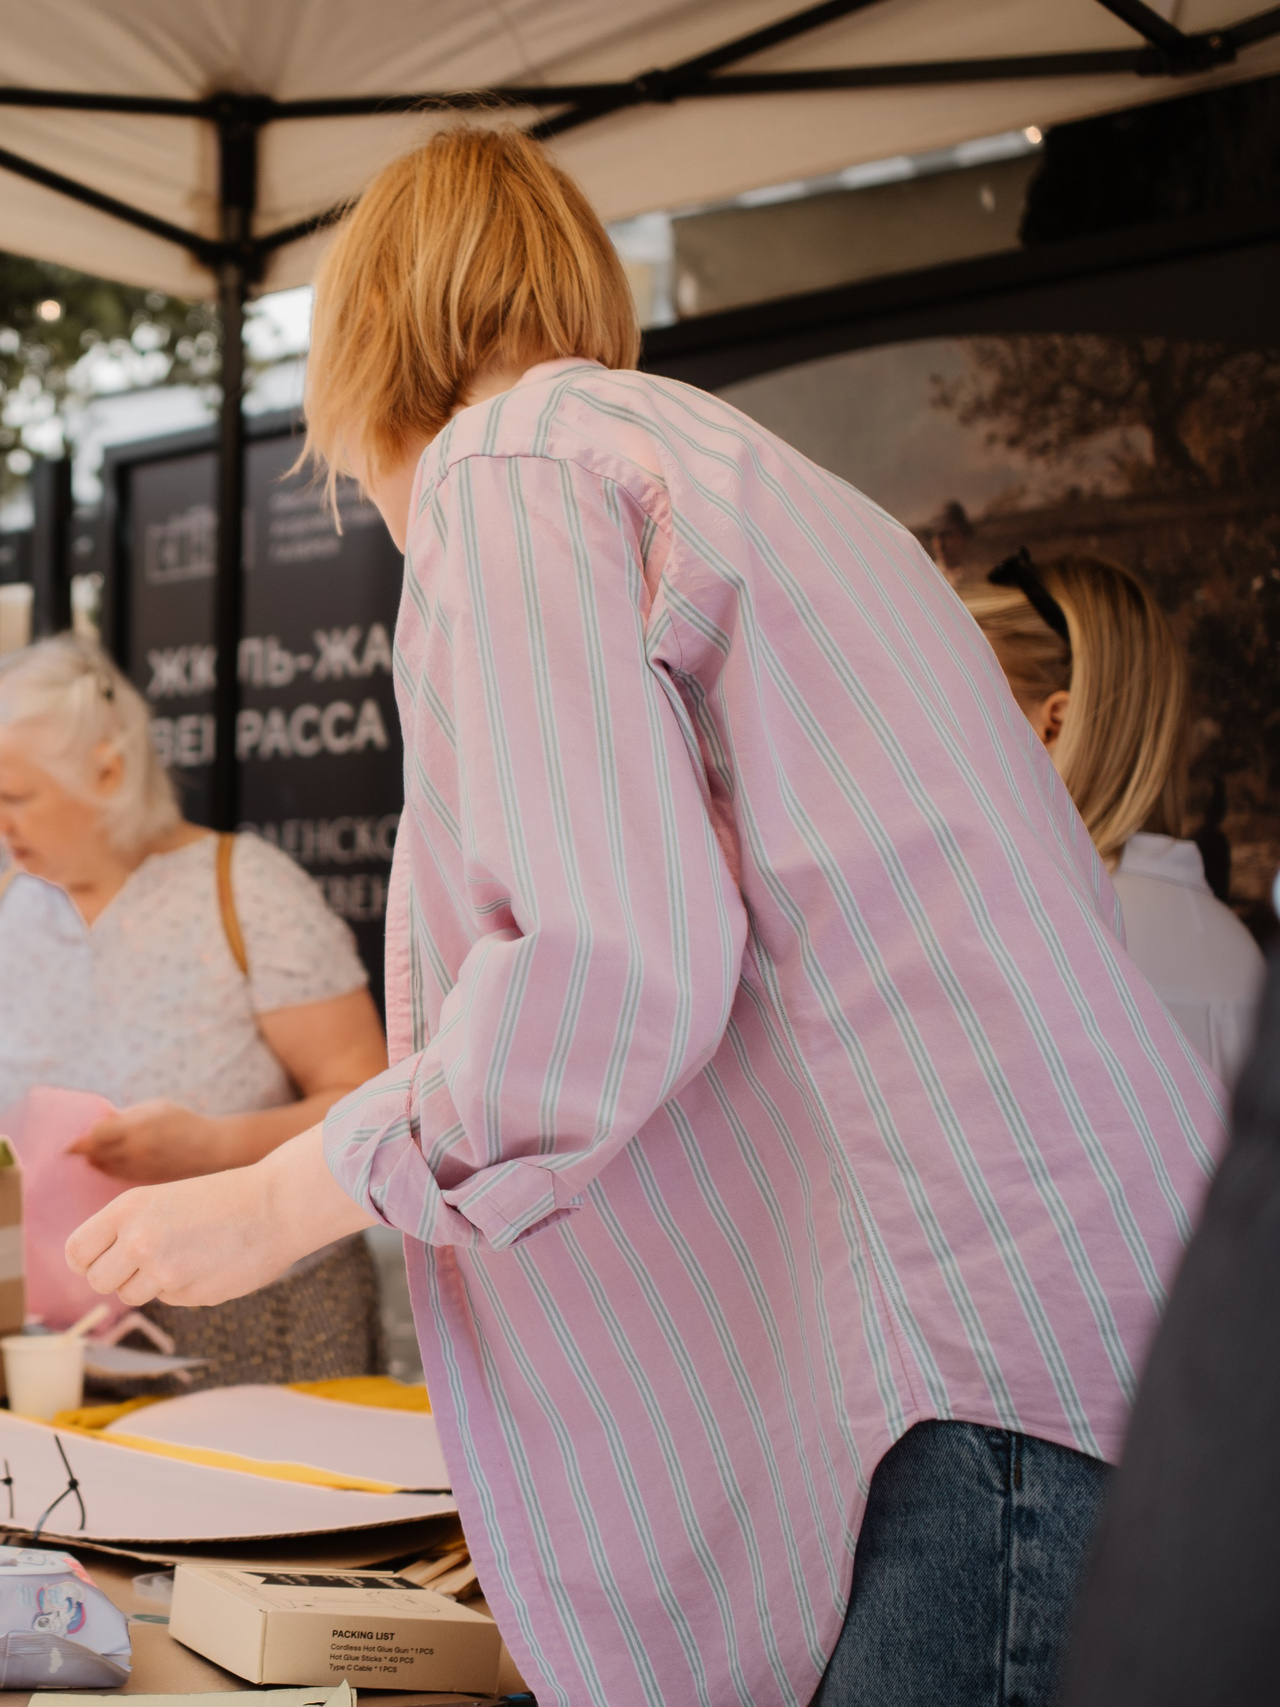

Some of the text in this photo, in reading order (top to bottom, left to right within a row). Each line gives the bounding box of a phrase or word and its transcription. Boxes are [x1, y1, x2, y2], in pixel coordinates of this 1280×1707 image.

[332, 1629, 395, 1641] PACKING LIST
[330, 1643, 361, 1652] Cordless
[363, 1645, 376, 1653] Hot
[376, 1645, 393, 1653] Glue
[394, 1646, 409, 1654] Gun
[329, 1653, 342, 1661] Hot
[343, 1654, 360, 1662] Glue
[361, 1654, 382, 1663] Sticks
[388, 1656, 398, 1664] 40
[399, 1657, 415, 1665] PCS
[329, 1663, 345, 1672] Type
[353, 1664, 373, 1672] Cable
